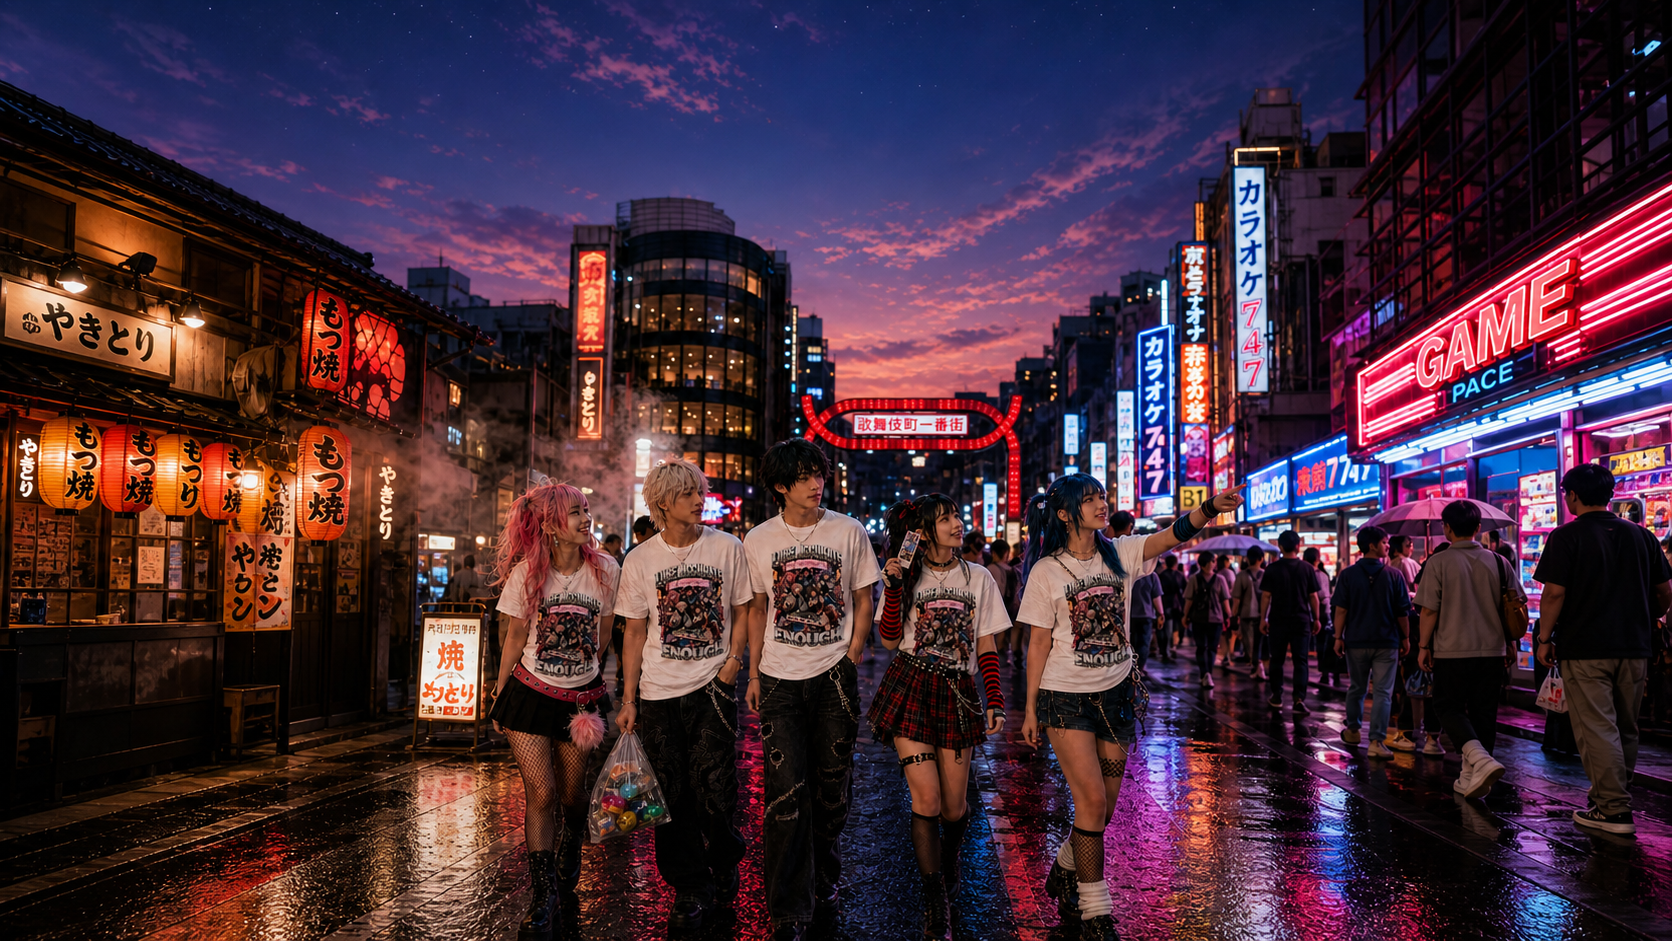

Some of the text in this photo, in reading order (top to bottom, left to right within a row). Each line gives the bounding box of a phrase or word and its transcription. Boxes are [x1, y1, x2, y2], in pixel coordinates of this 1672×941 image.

[1239, 180, 1265, 387] カラオケ747
[41, 302, 154, 362] やきとり
[311, 297, 343, 383] もつ焼
[1415, 258, 1578, 390] GAME
[1144, 336, 1165, 494] カラオケ747
[1452, 360, 1514, 404] PACE
[65, 422, 98, 501] もつ焼
[857, 417, 964, 432] 歌舞伎町一番街
[19, 438, 38, 497] やきとり
[124, 430, 155, 505] もつ焼
[308, 435, 345, 526] もつ焼
[379, 466, 396, 540] やきとり
[1183, 489, 1204, 507] B1
[774, 626, 843, 647] ENOUGH
